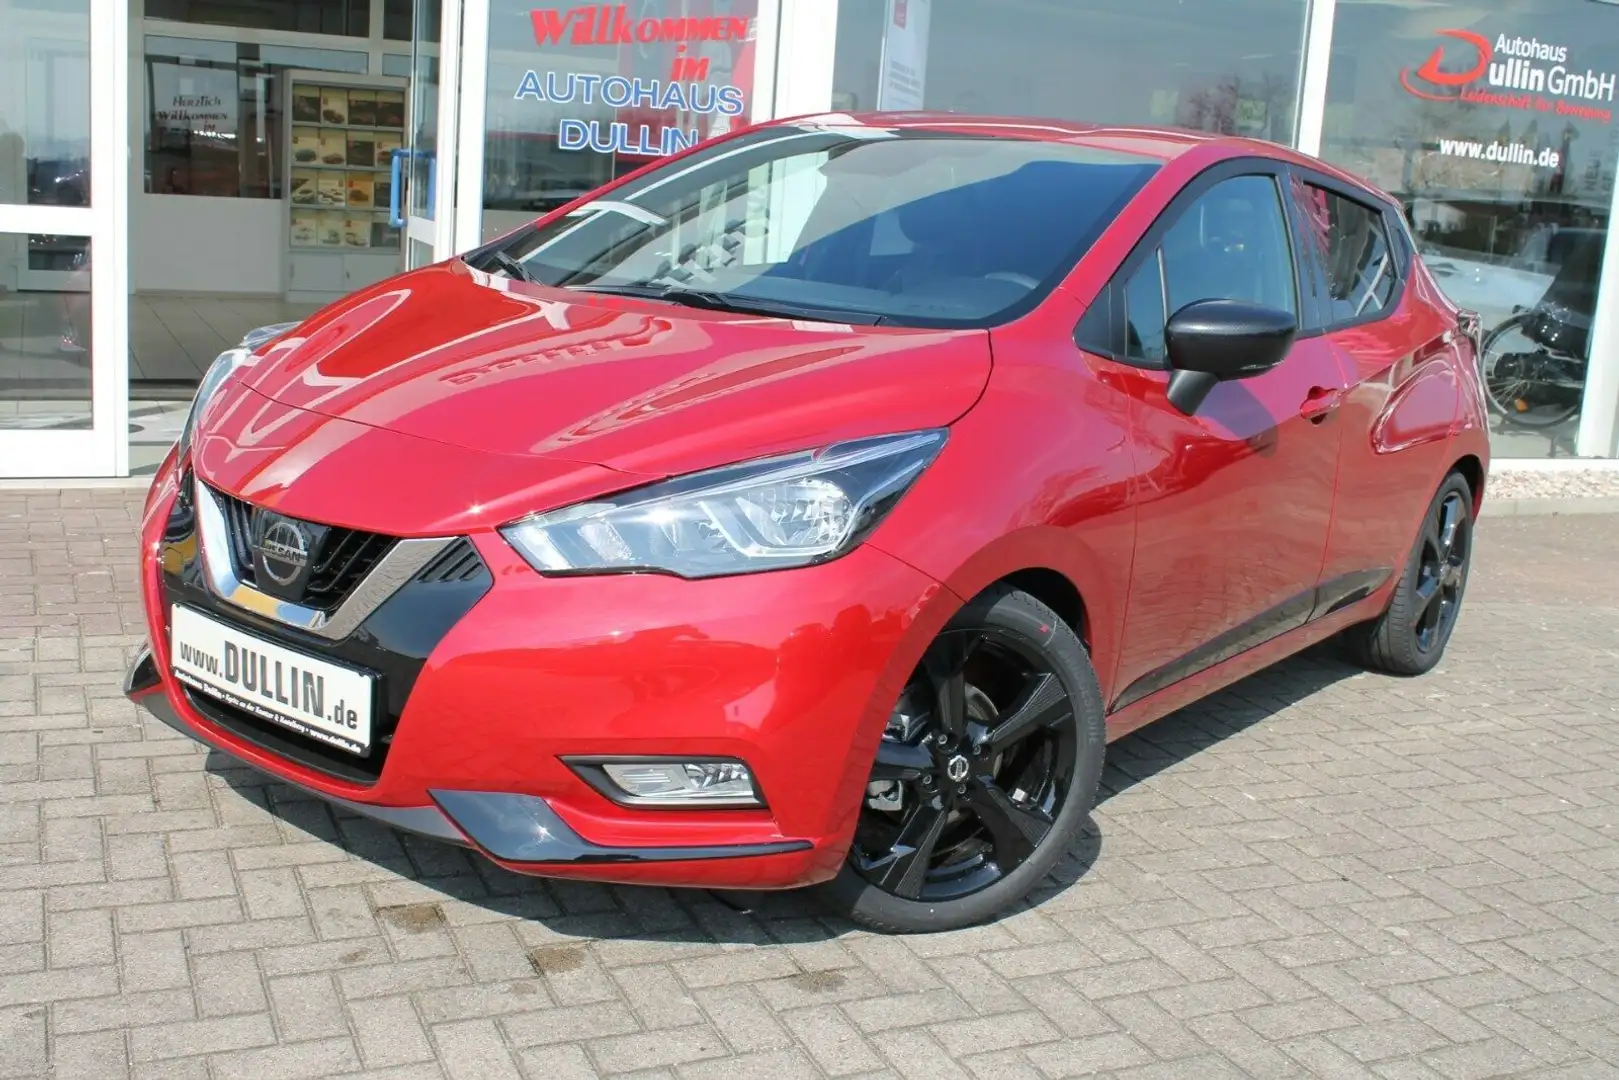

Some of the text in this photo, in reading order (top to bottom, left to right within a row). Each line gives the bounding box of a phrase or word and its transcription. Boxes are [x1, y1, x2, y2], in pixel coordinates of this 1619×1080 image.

[1494, 33, 1567, 62] Autohaus
[514, 70, 744, 115] AUTOHAUS
[1548, 66, 1616, 101] GmbH
[559, 119, 699, 156] DULLIN
[1440, 138, 1560, 168] www.dullin.de
[180, 640, 358, 730] www.DULLIN.de
